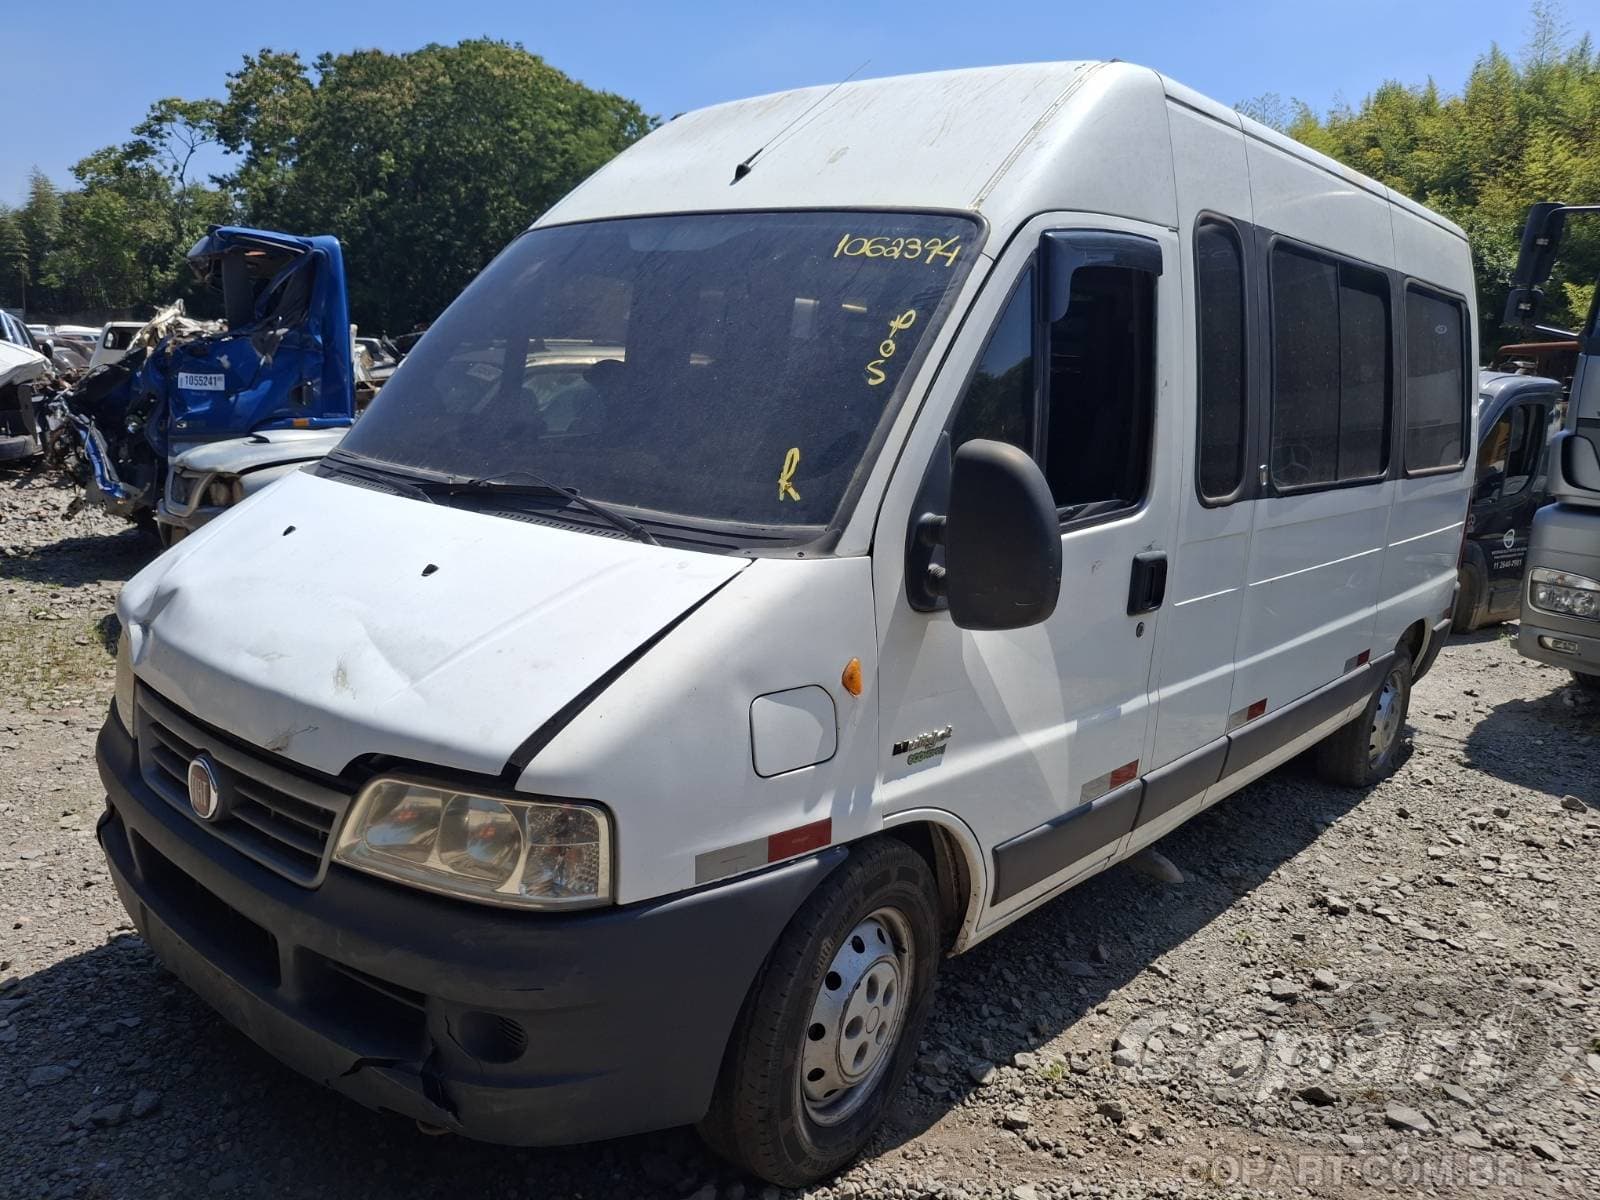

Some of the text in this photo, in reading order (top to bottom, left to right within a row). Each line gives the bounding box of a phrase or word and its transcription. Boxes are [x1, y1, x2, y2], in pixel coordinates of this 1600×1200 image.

[833, 233, 962, 267] 1062394
[185, 375, 217, 386] 1055241
[778, 447, 801, 501] R
